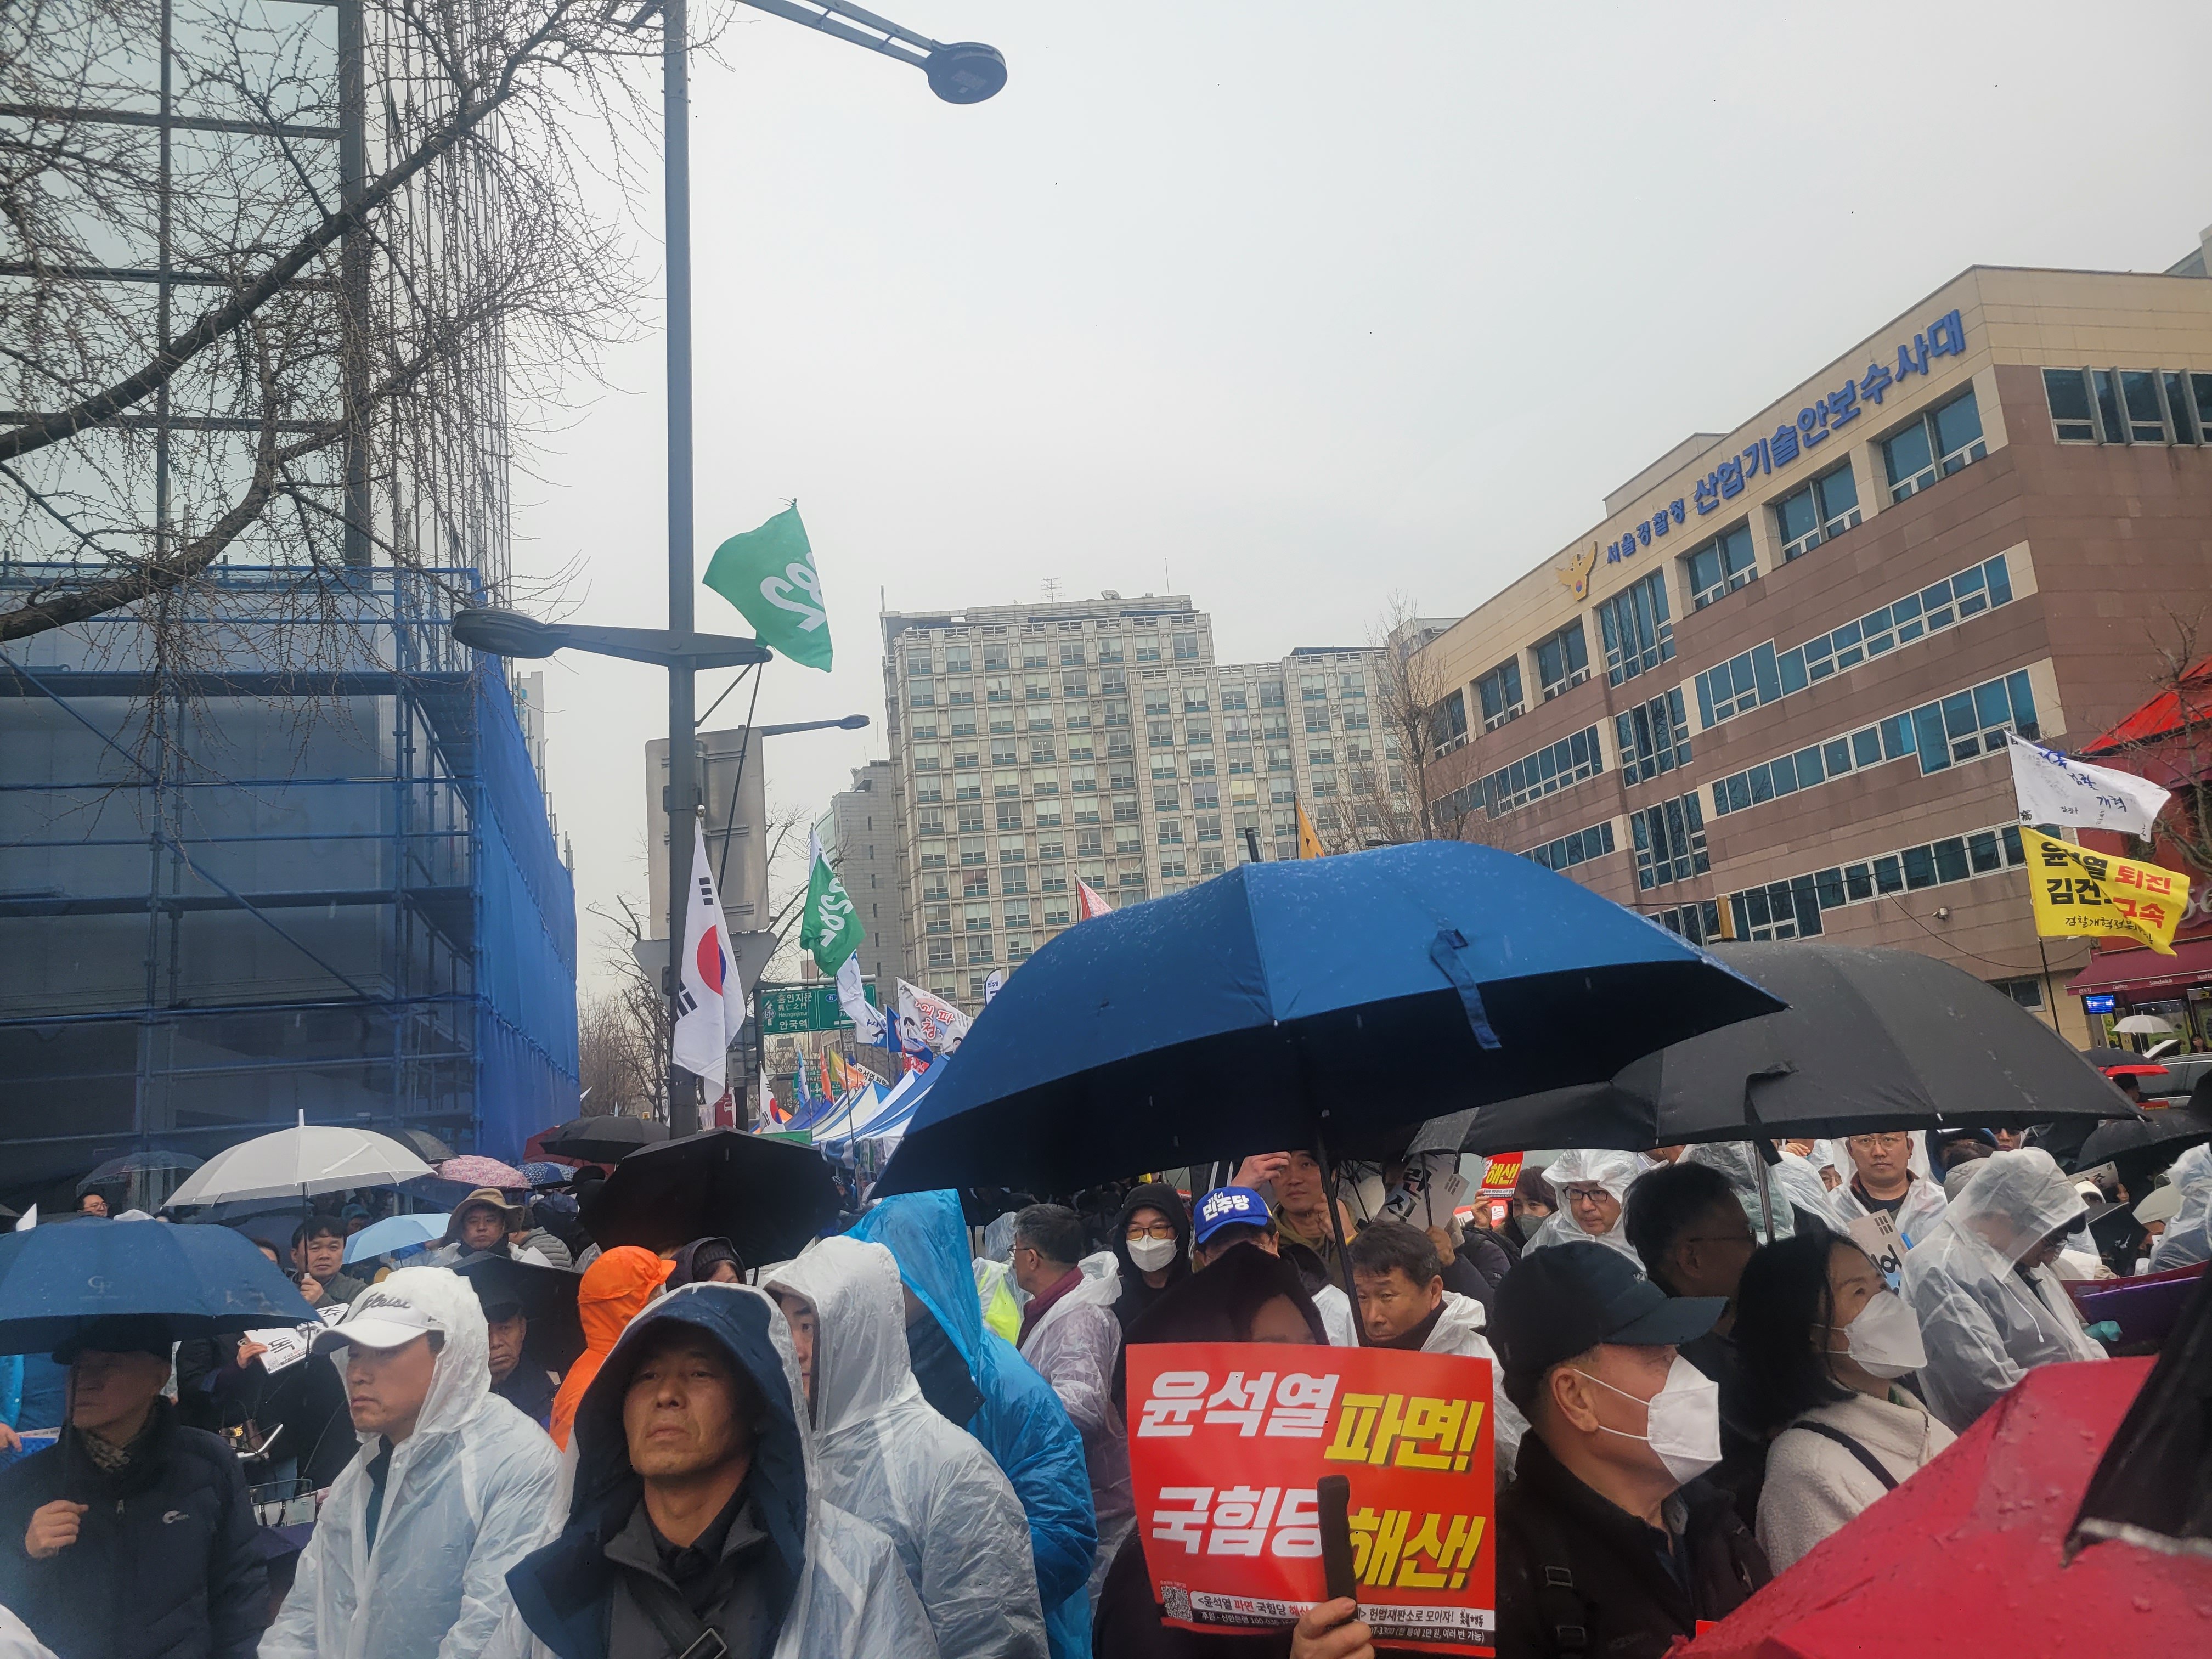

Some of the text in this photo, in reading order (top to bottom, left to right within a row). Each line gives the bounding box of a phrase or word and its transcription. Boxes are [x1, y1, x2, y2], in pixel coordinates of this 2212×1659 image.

[1607, 309, 1966, 563] 서울경찰청 산업기술안보수사대
[2114, 865, 2171, 895] 퇴진
[2046, 878, 2113, 905] 김건
[2113, 897, 2165, 929] 구속
[777, 992, 812, 1004] 흥인지문
[779, 1019, 808, 1030] 안국역
[1485, 1163, 1521, 1184] 해산!
[1203, 1194, 1250, 1221] 민주당
[1137, 1370, 1485, 1472] 윤석열 파면!
[1347, 1507, 1486, 1589] 해산!
[1234, 1599, 1255, 1612] 파면
[1256, 1601, 1286, 1616] 국힘당
[1369, 1607, 1423, 1622] 헌법재판소로
[1426, 1610, 1454, 1623] 모이자!
[1443, 1630, 1456, 1639] 여러
[1457, 1632, 1465, 1641] 번
[1466, 1632, 1485, 1643] 가능)
